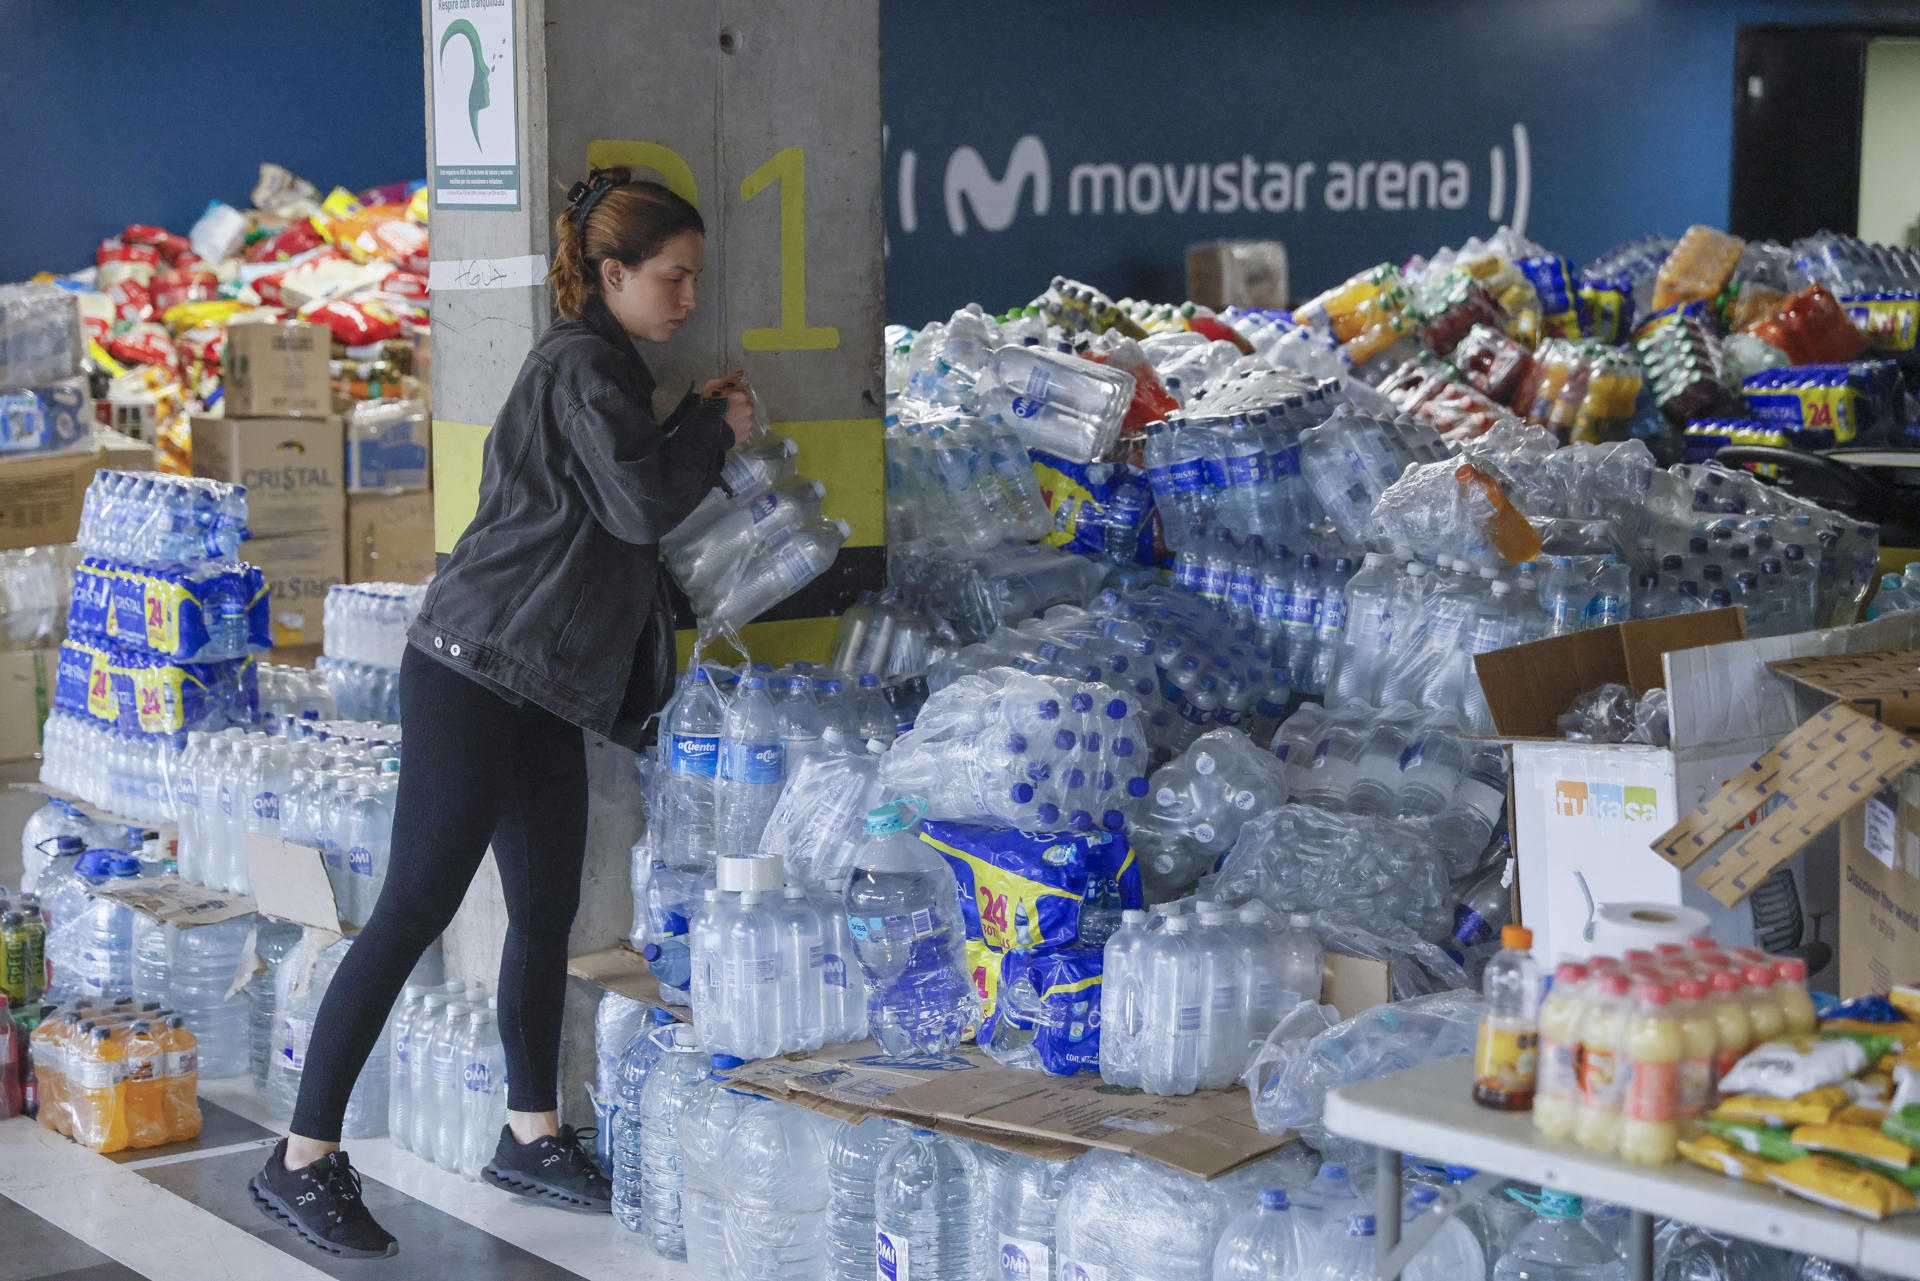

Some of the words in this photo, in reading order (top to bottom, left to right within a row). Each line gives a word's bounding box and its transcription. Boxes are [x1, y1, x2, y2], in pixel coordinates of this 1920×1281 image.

[1070, 154, 1316, 213] movistar
[1324, 160, 1470, 211] arena
[1807, 403, 1833, 428] 24
[240, 467, 334, 489] CRISTAL
[147, 597, 164, 629] 24
[91, 669, 107, 699] 24
[142, 687, 161, 715] 24
[1556, 789, 1657, 825] tukasa
[348, 851, 370, 864] OMI
[1847, 864, 1880, 901] Discover
[980, 886, 1008, 933] 24
[1001, 1252, 1028, 1274] OMI
